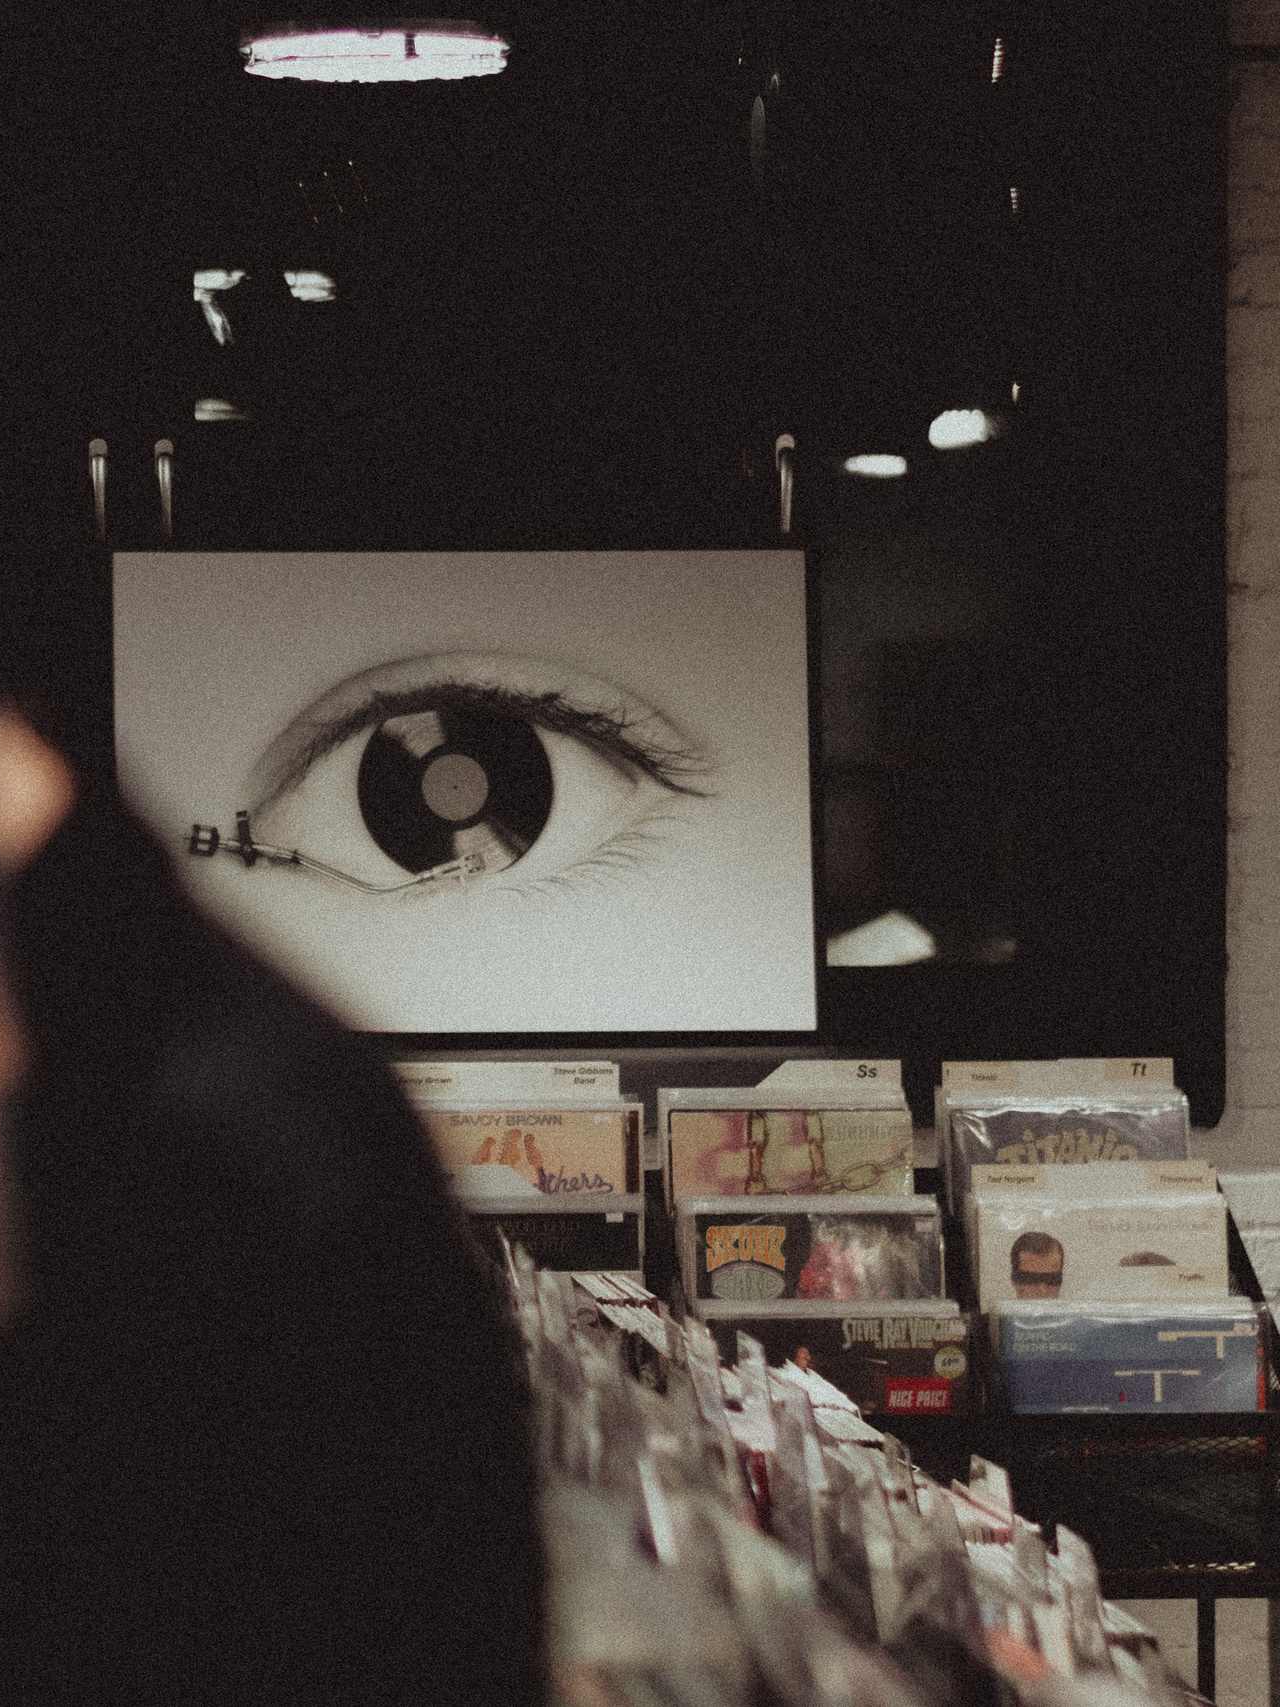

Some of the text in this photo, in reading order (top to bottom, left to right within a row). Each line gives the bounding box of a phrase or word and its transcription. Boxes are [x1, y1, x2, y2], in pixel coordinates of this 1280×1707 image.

[856, 1064, 878, 1079] Ss
[1130, 1062, 1148, 1077] Tt
[449, 1114, 563, 1127] SAVOY BROWN
[705, 1224, 787, 1273] SKUNK
[888, 1390, 948, 1407] NICE PRICE
